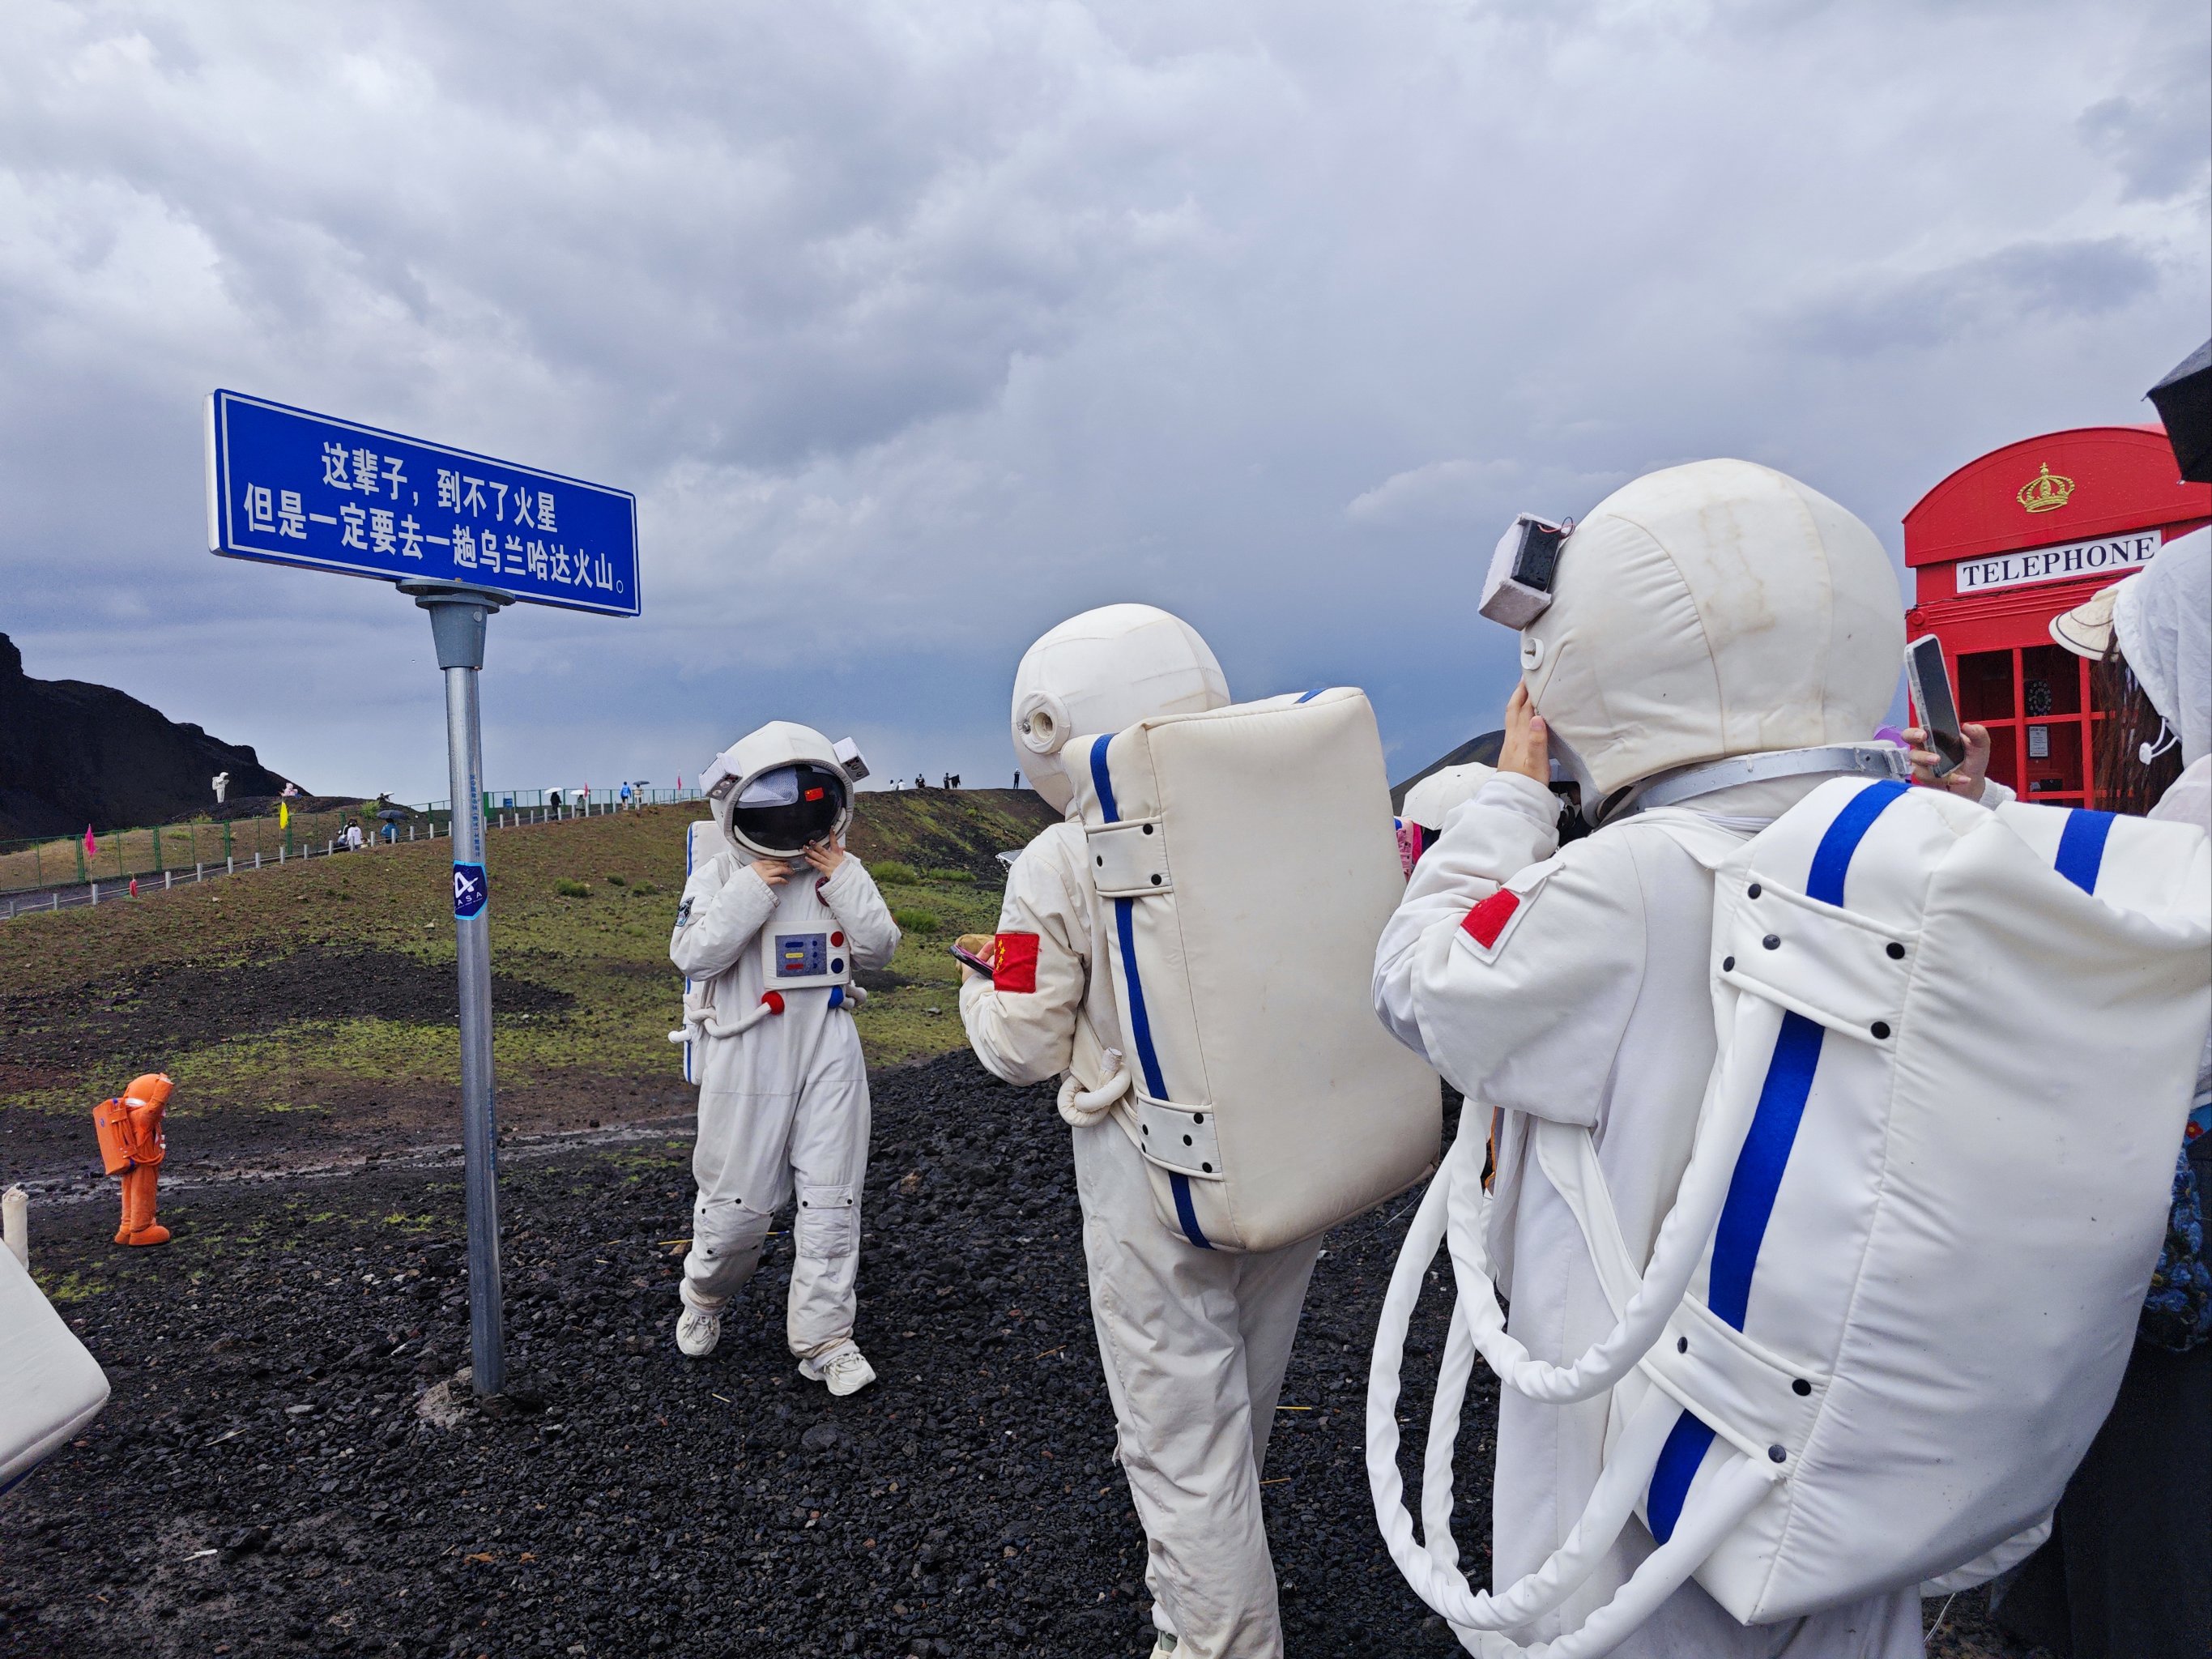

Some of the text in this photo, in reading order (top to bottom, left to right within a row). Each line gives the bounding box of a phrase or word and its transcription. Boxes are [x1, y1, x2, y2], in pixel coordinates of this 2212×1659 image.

[321, 441, 558, 533] 这辈子，到不了火星
[244, 482, 624, 594] 但是一定要去一趟乌兰哈达火山。
[1963, 536, 2155, 586] TELEPHONE
